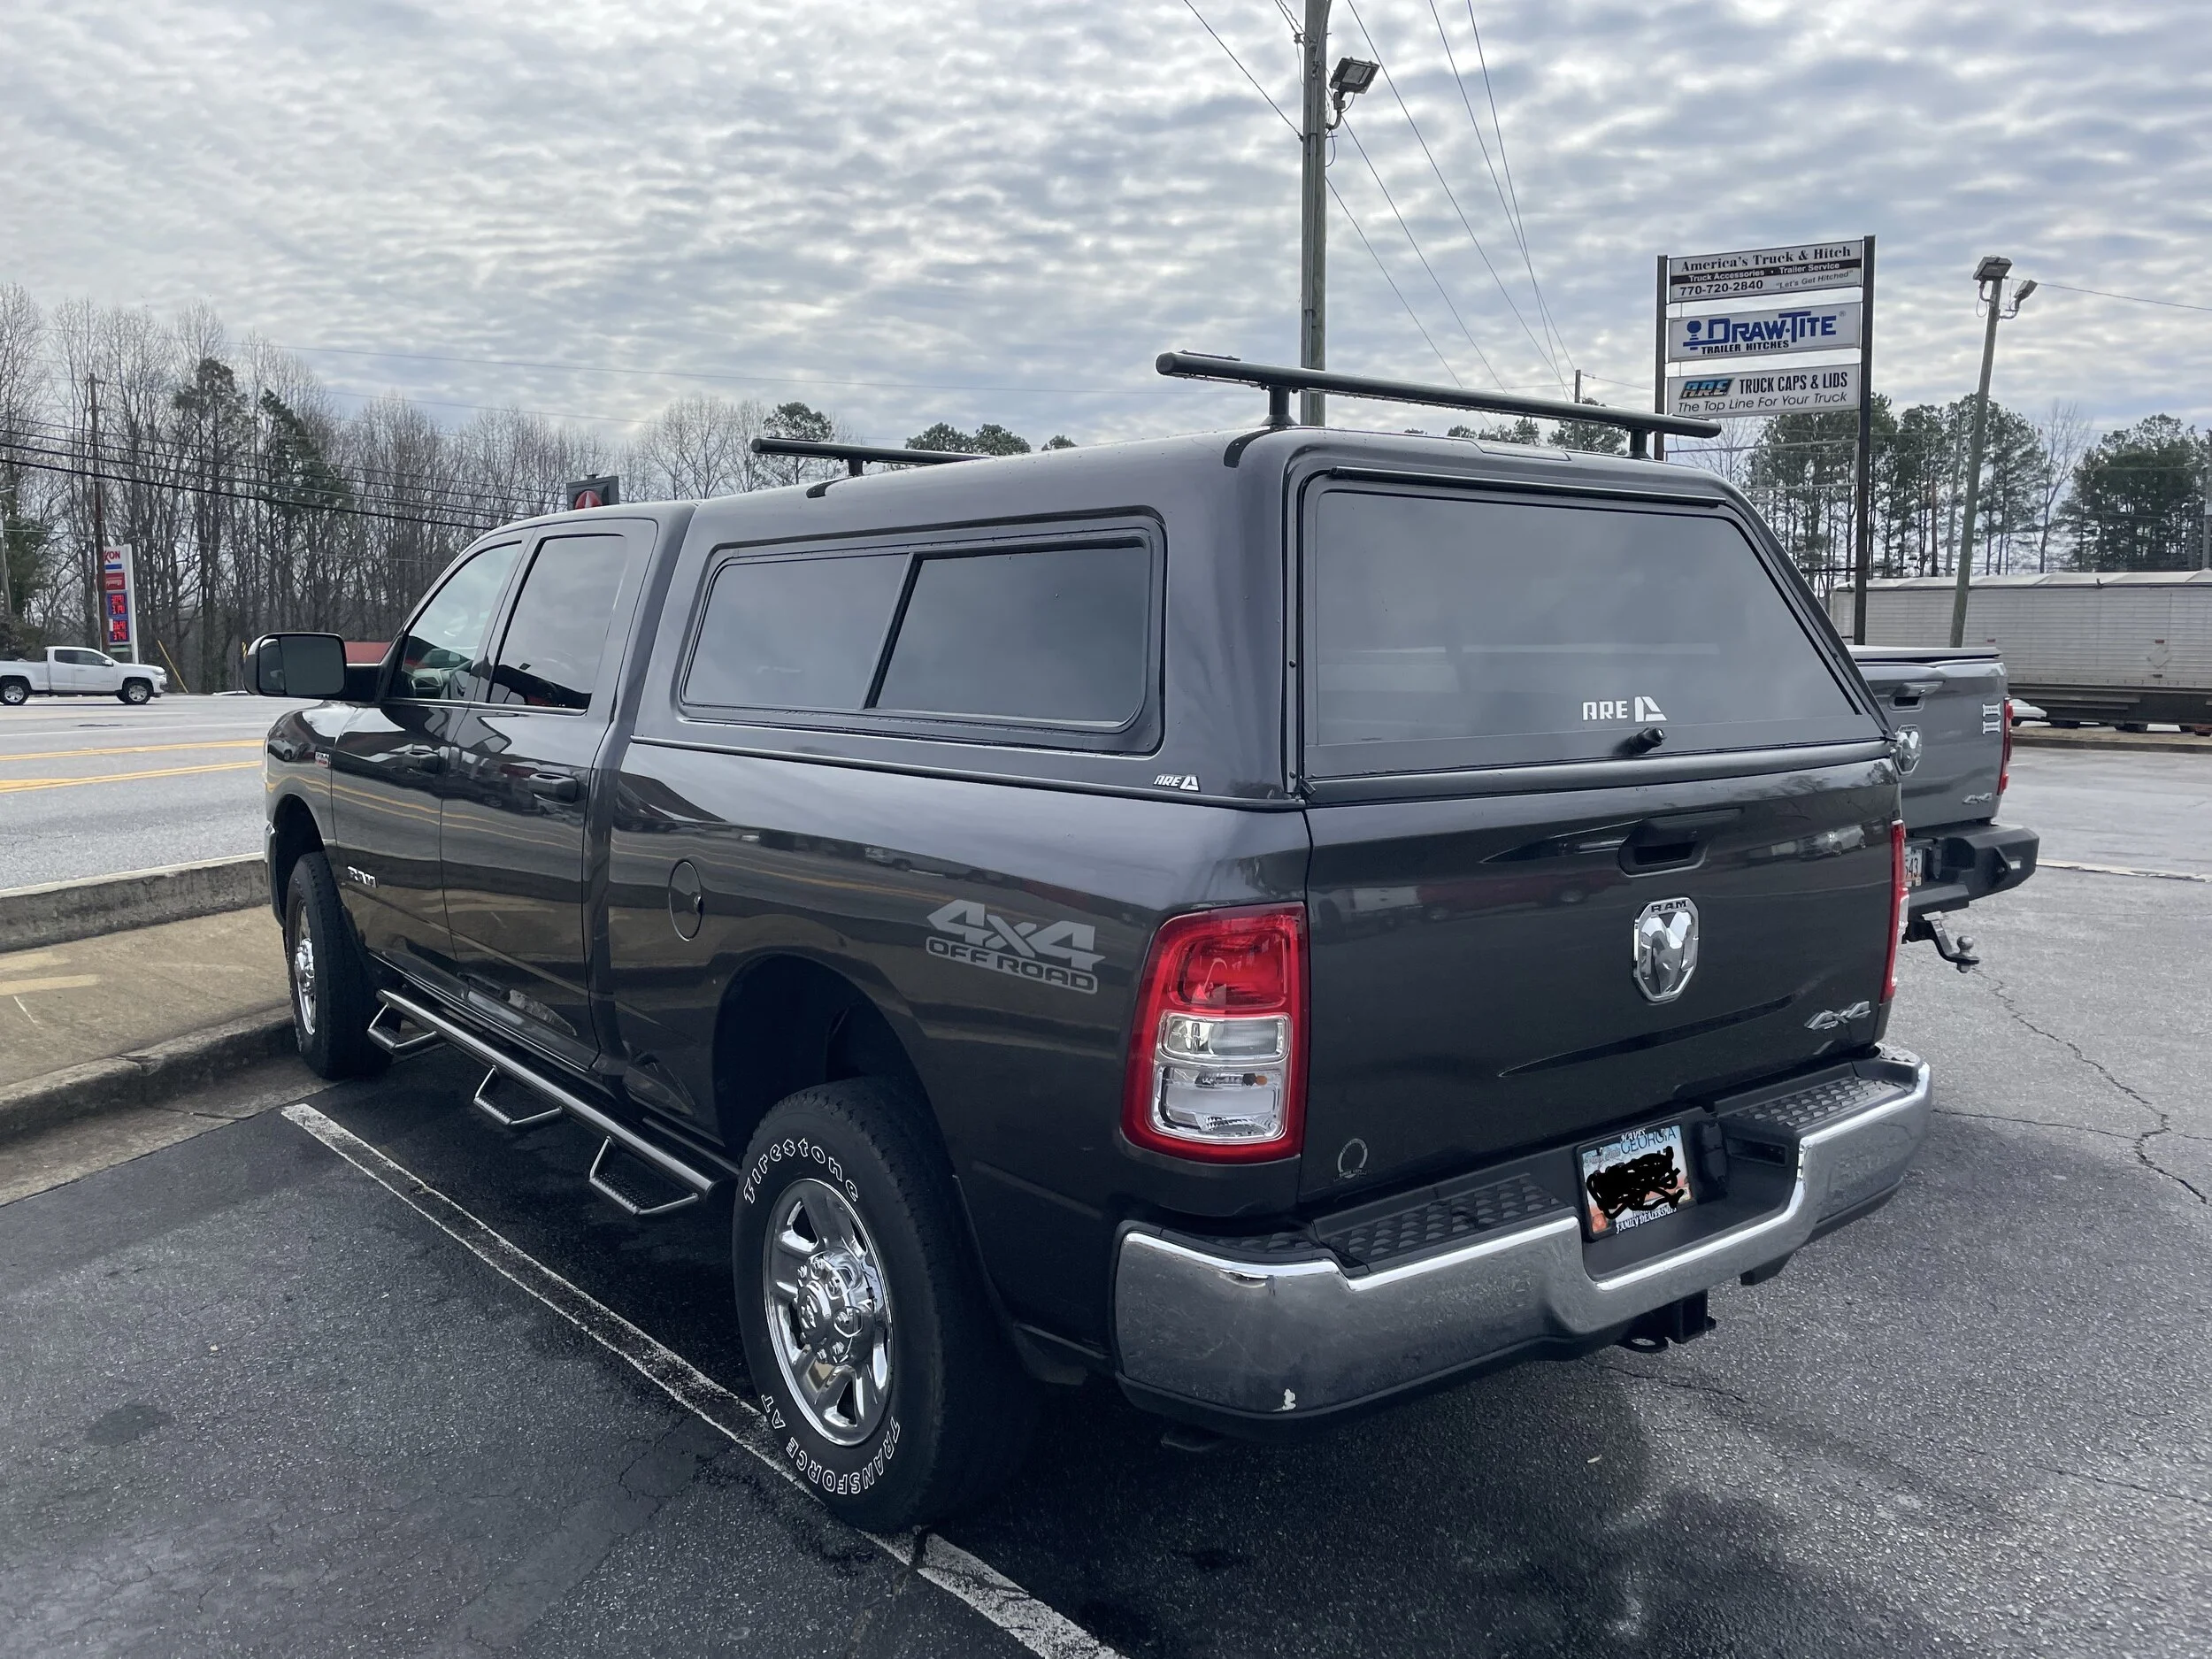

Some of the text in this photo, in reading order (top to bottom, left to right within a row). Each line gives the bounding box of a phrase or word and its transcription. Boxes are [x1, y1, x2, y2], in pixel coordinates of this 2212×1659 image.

[1681, 246, 1851, 272] America's Truck & Hitch
[1688, 262, 1840, 283] Truck Accessories Trailer Service
[1801, 277, 1816, 286] Get
[1680, 280, 1763, 296] 770-720-2840
[1701, 340, 1789, 355] TRAILER HITCHES
[1740, 376, 1774, 395] TRUCK
[1778, 374, 1807, 392] CAPS
[1810, 373, 1819, 389] &
[1823, 372, 1847, 388] LIDS
[1678, 391, 1847, 413] The Top Line For Your Truck
[1582, 700, 1628, 720] ARE
[1153, 775, 1182, 787] ARE
[1651, 901, 1686, 913] RAM
[929, 939, 1095, 992] OFF ROAD
[1620, 1126, 1678, 1155] GEORGIA
[743, 1138, 859, 1203] Firestone
[761, 1394, 901, 1495] TRANSFORCE AT
